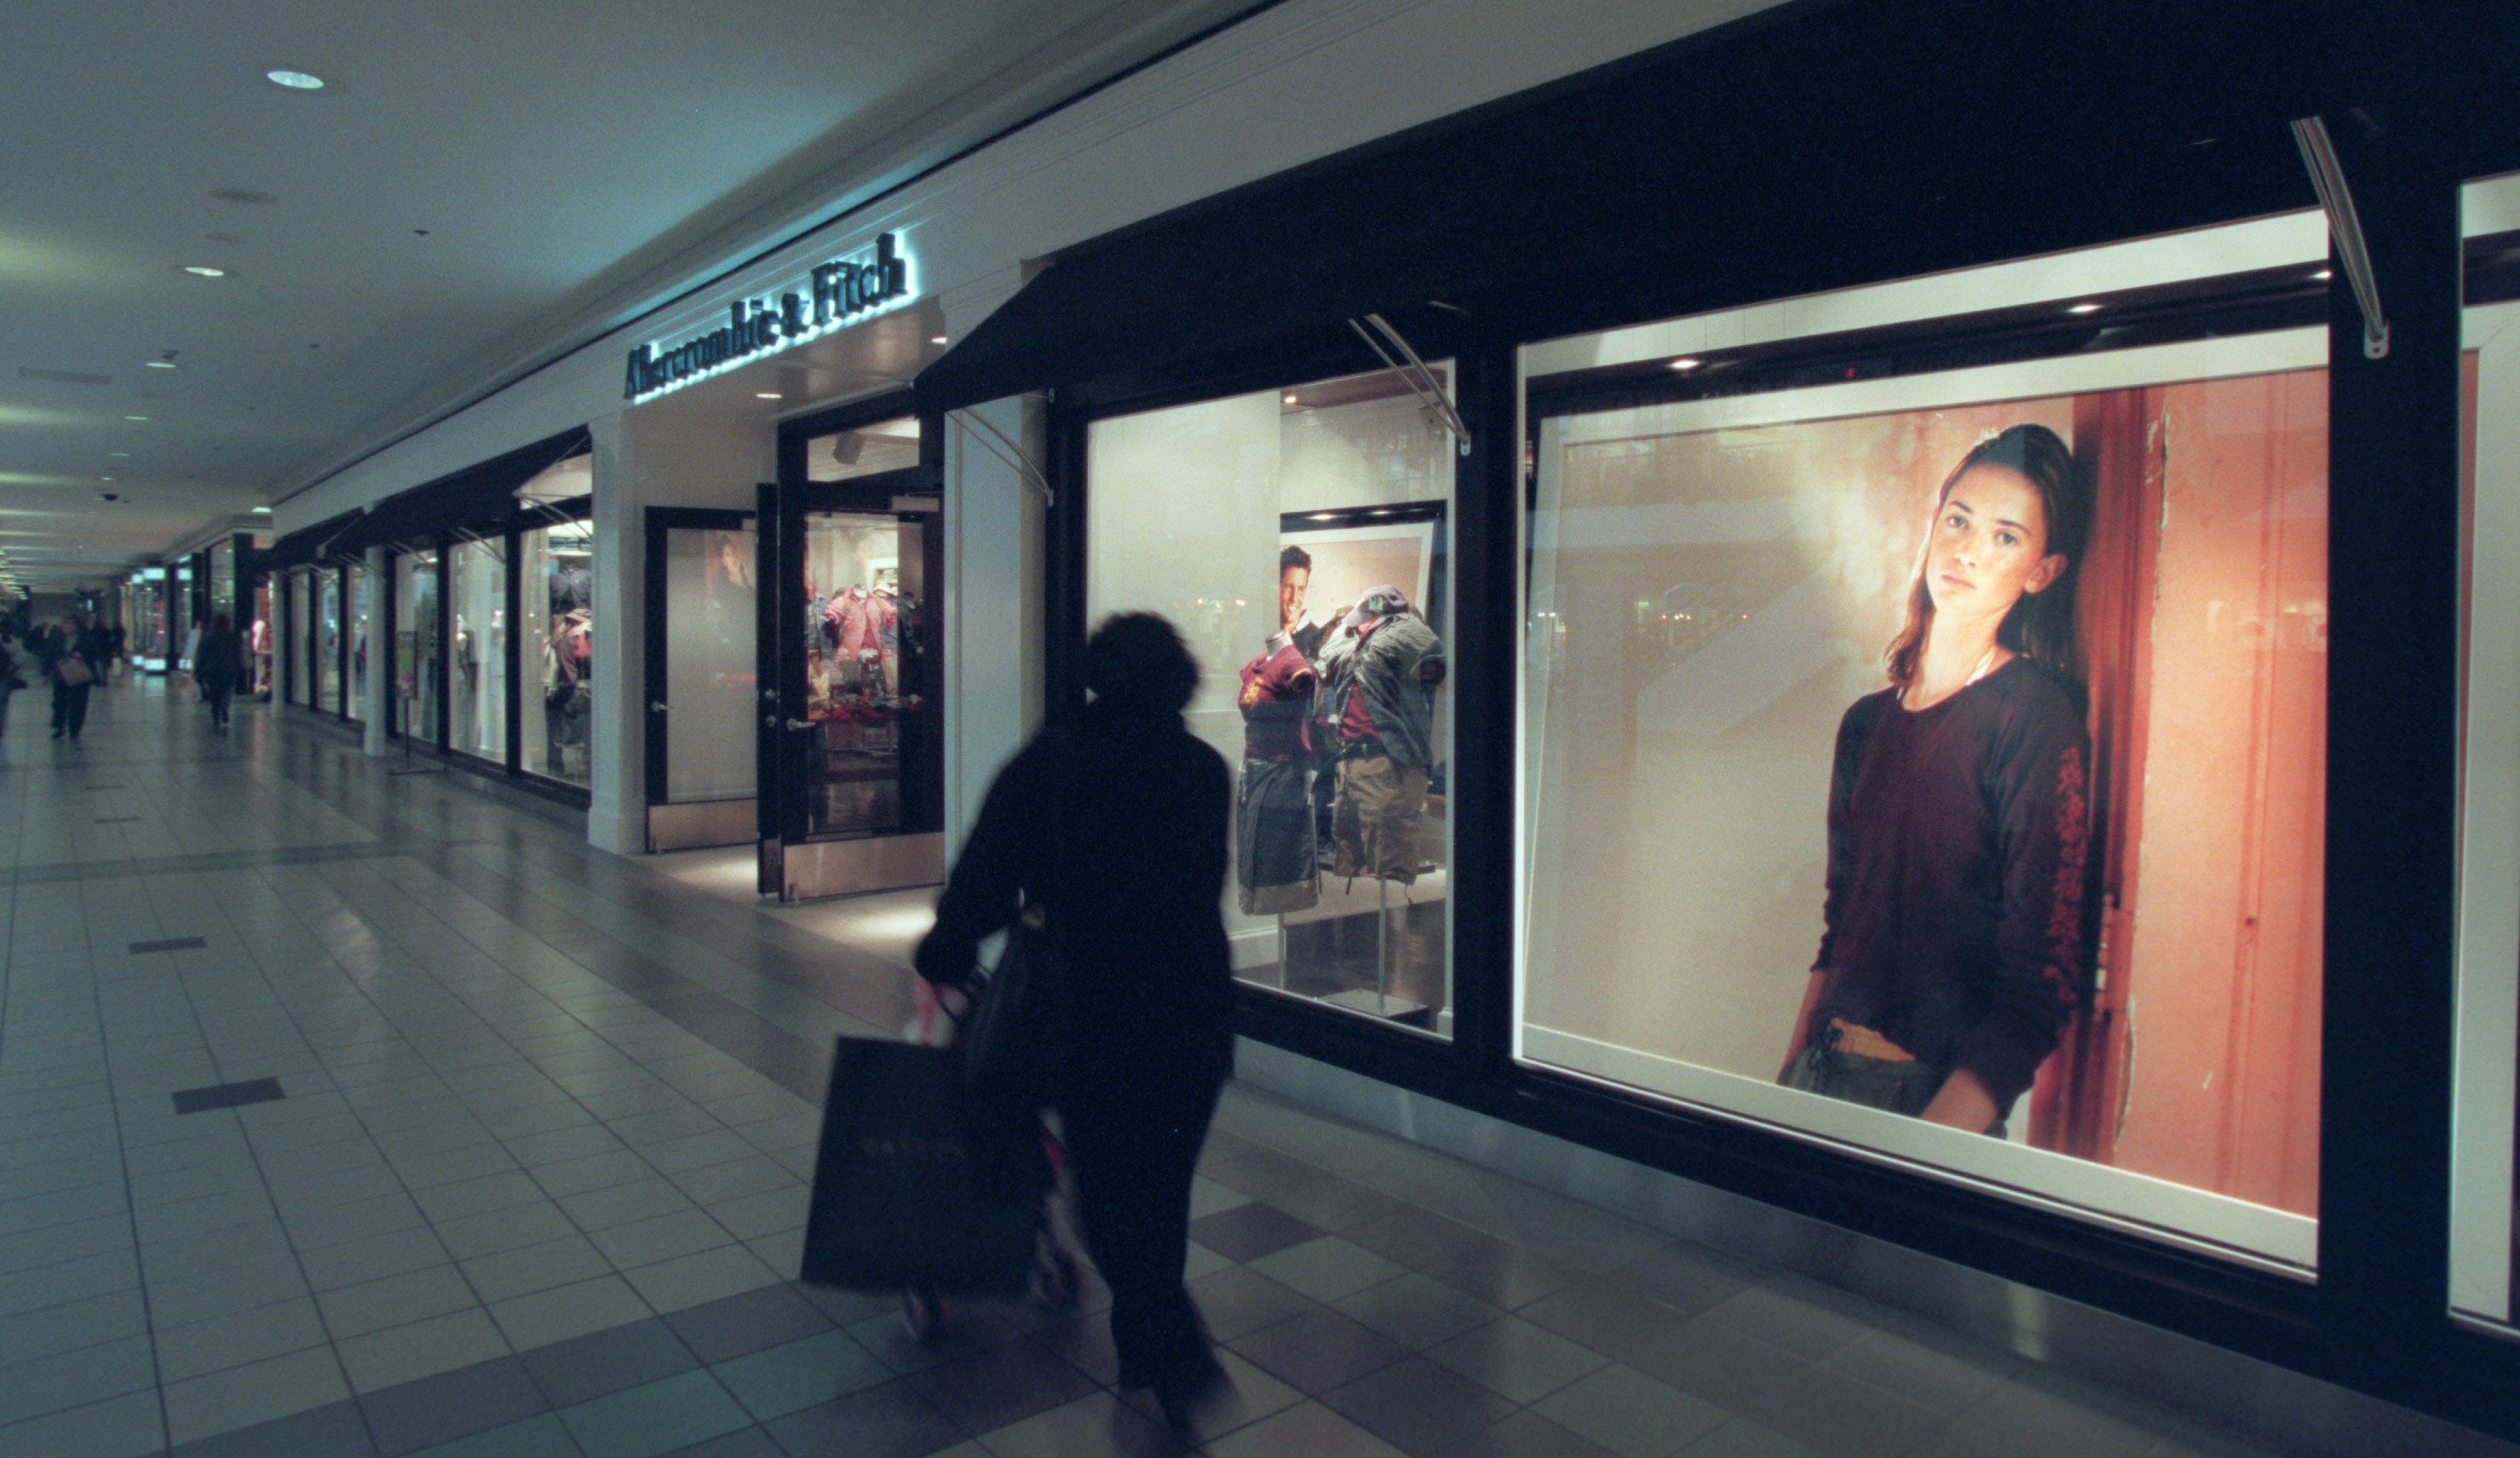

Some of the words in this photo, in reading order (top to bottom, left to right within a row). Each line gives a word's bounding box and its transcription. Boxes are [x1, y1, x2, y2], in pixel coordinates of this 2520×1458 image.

[624, 301, 780, 399] Abercrombie
[781, 292, 809, 337] &
[811, 232, 907, 326] Fitch
